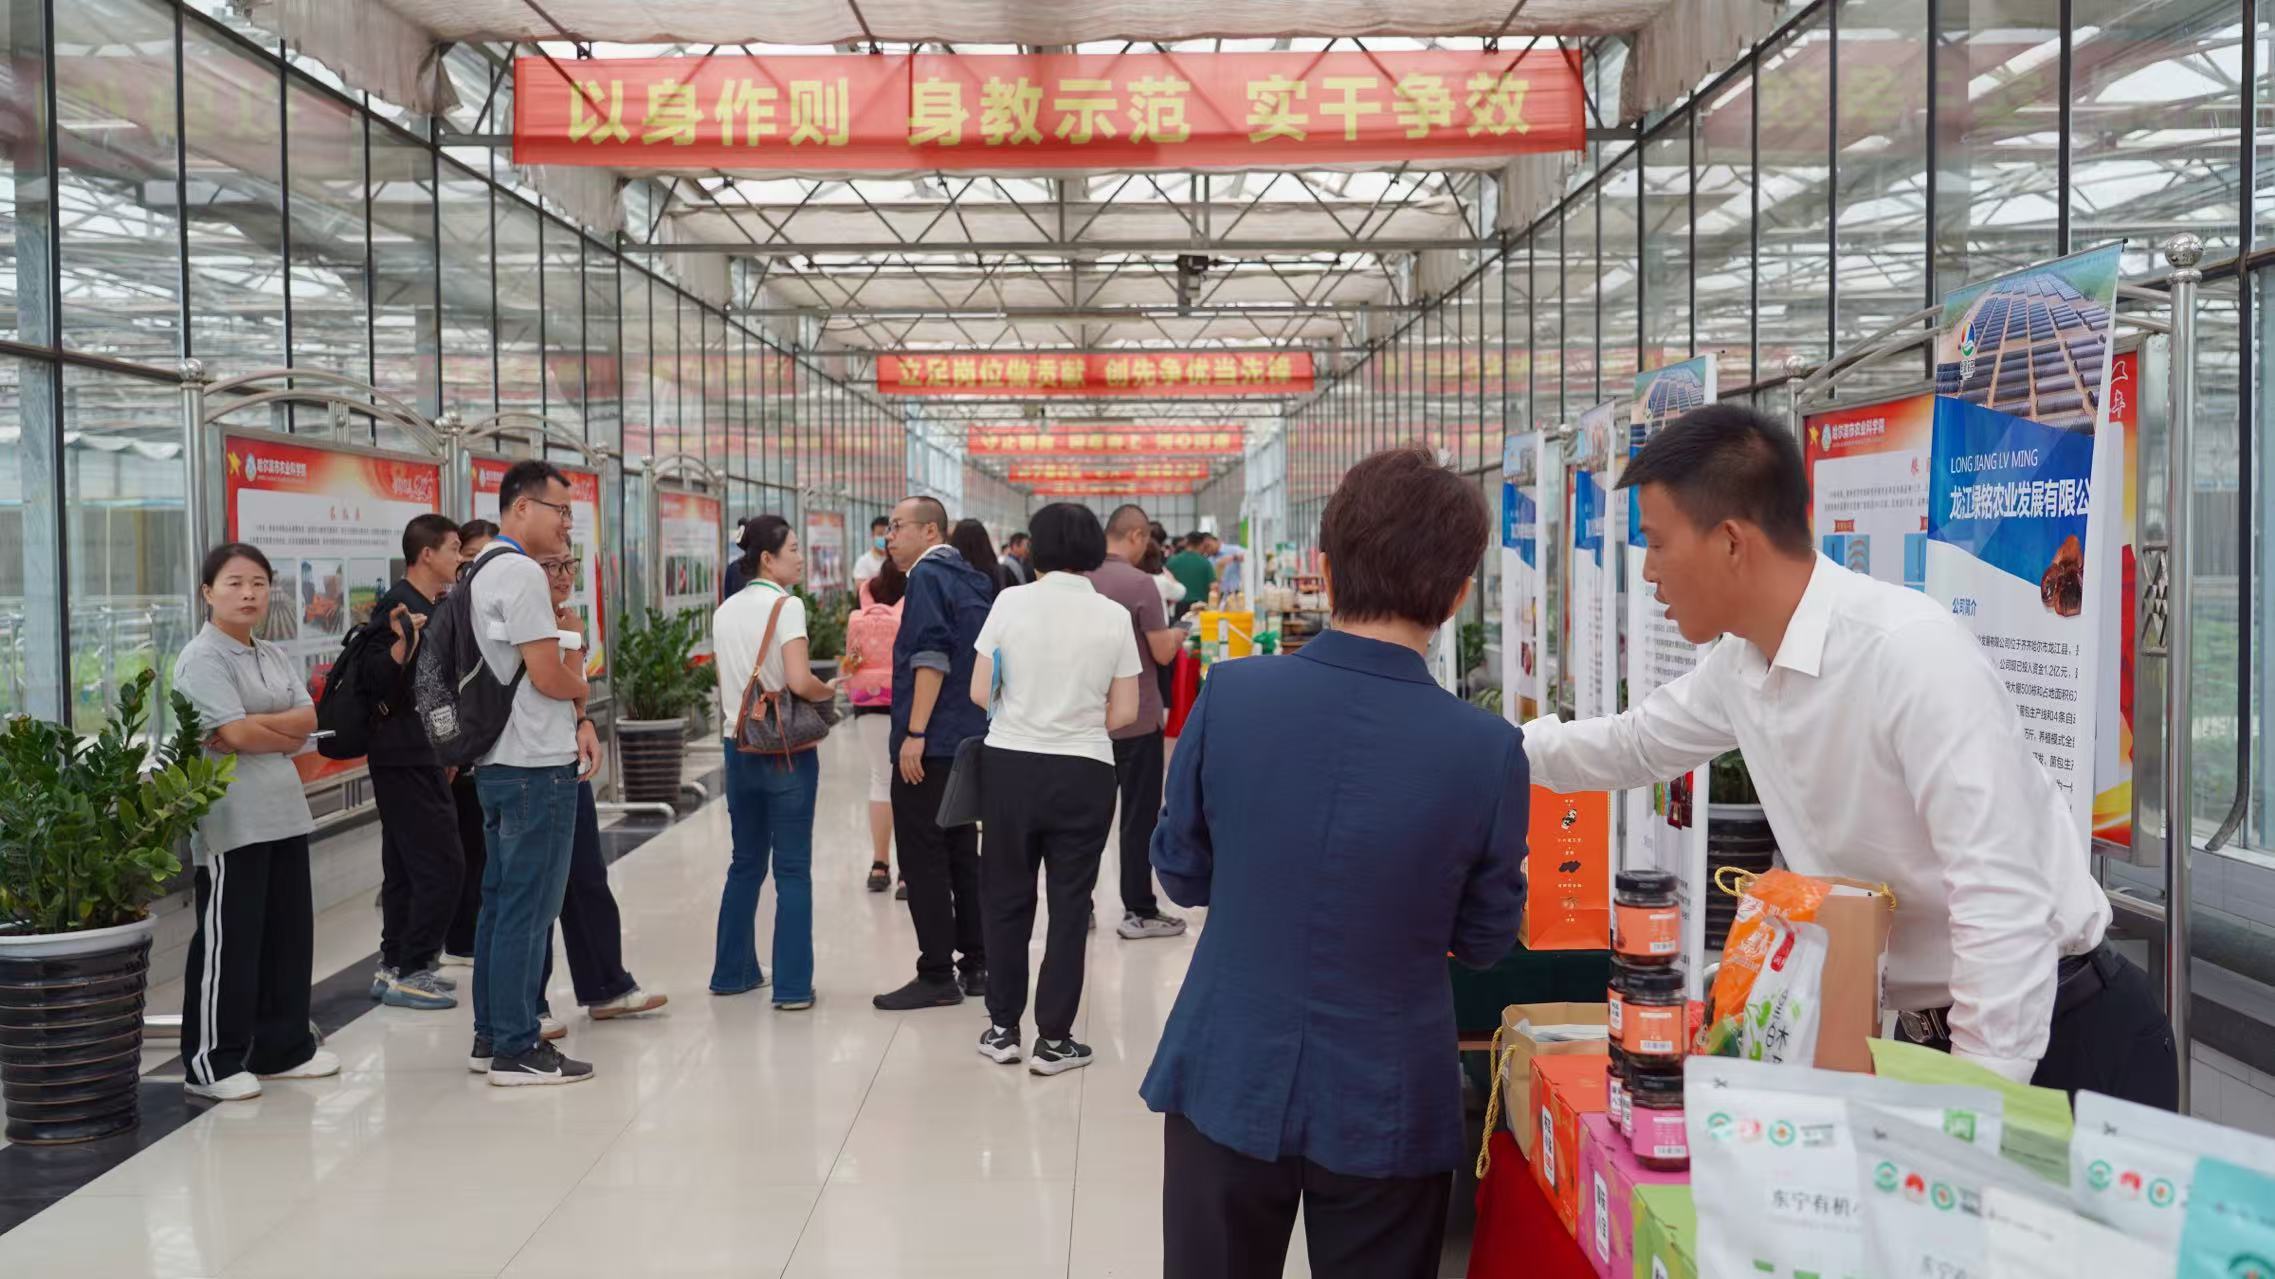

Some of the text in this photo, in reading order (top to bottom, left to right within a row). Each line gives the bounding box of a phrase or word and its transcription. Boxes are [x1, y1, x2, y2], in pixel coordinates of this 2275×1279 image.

[568, 72, 1532, 148] 以身作则 身教示范 实干争效
[899, 357, 1086, 387] 立足岗位做贡献
[1950, 455, 1973, 473] LONG
[1974, 452, 1997, 472] JIANG
[1998, 450, 2011, 468] LV
[2012, 448, 2039, 467] MING
[1773, 1189, 1858, 1217] 东宁有机
